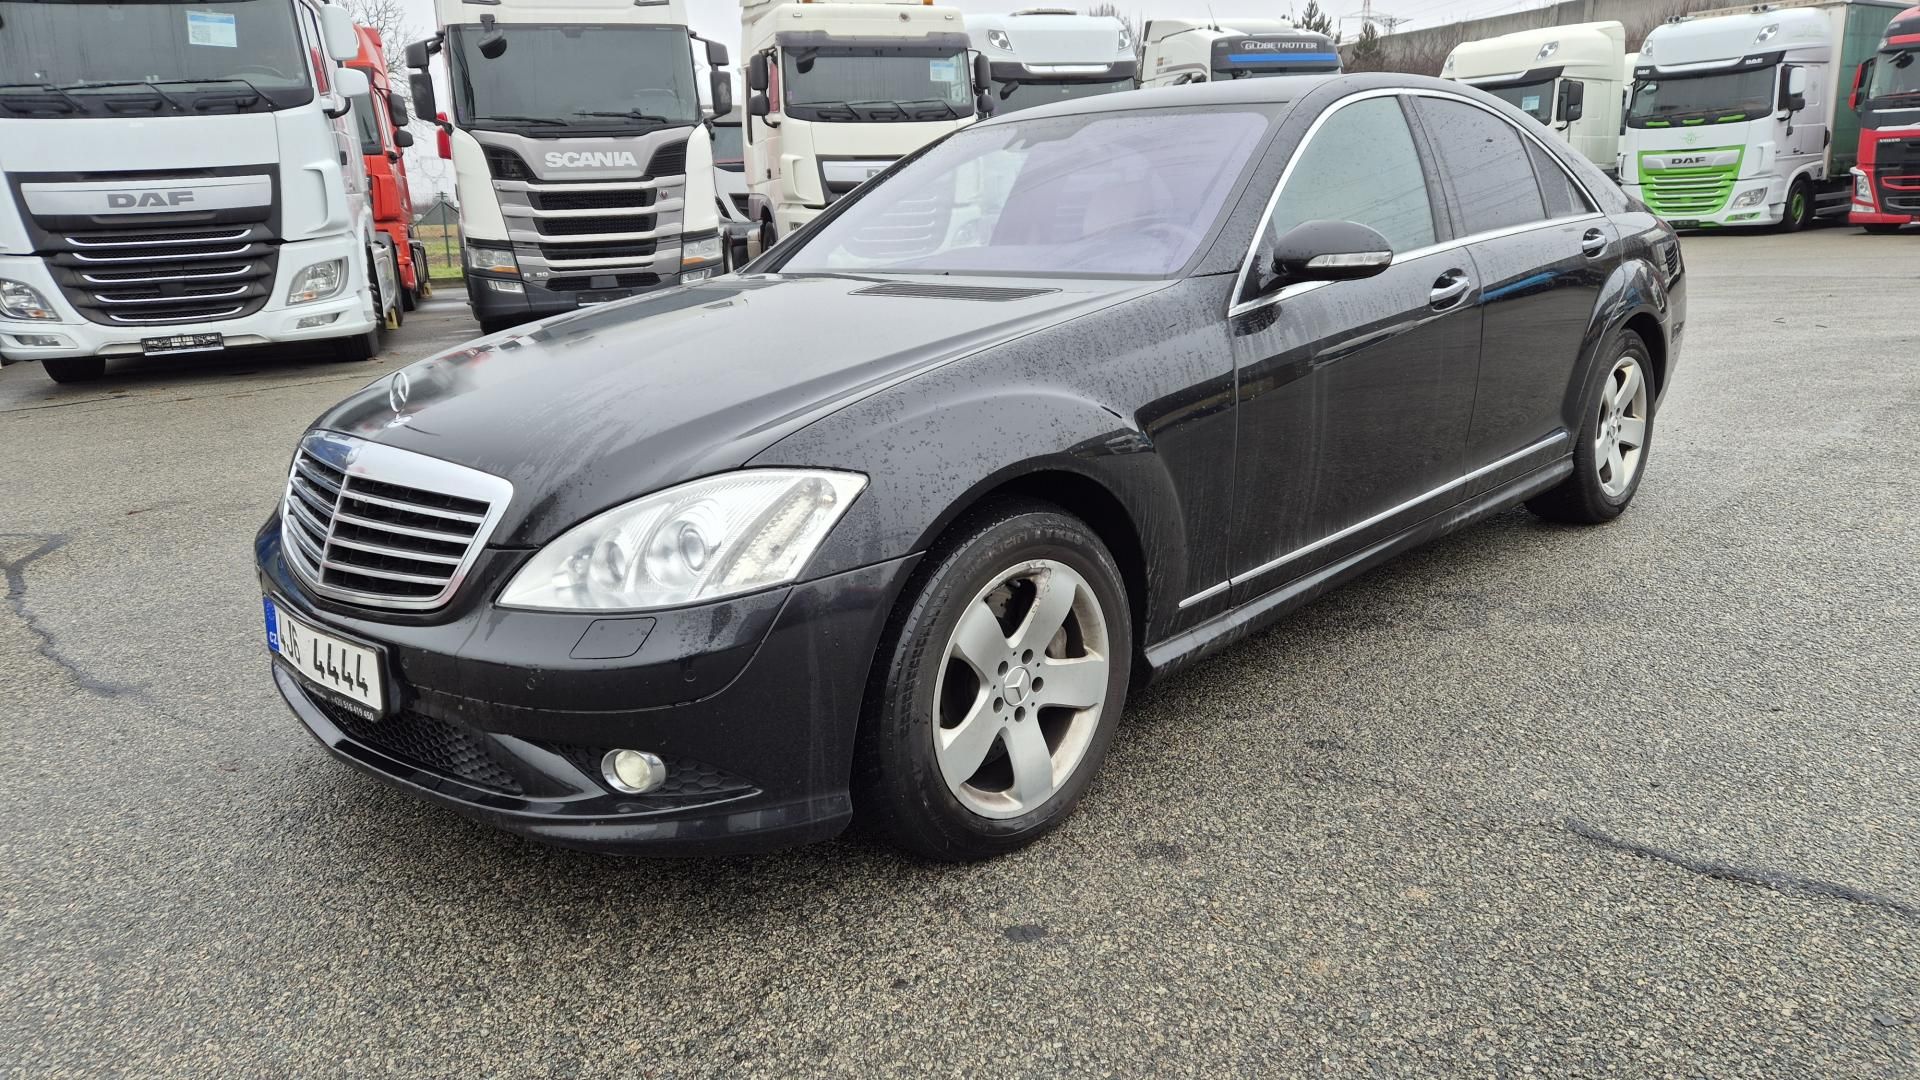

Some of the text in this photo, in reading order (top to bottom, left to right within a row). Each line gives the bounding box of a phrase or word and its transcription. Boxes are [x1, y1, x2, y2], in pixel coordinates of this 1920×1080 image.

[1243, 40, 1318, 50] GLOBETROTTER
[1745, 57, 1763, 65] DAF
[545, 151, 638, 168] SCANIA
[1671, 156, 1706, 165] DAF
[107, 190, 195, 209] DAF
[269, 631, 278, 645] CZ
[313, 637, 369, 698] 4444
